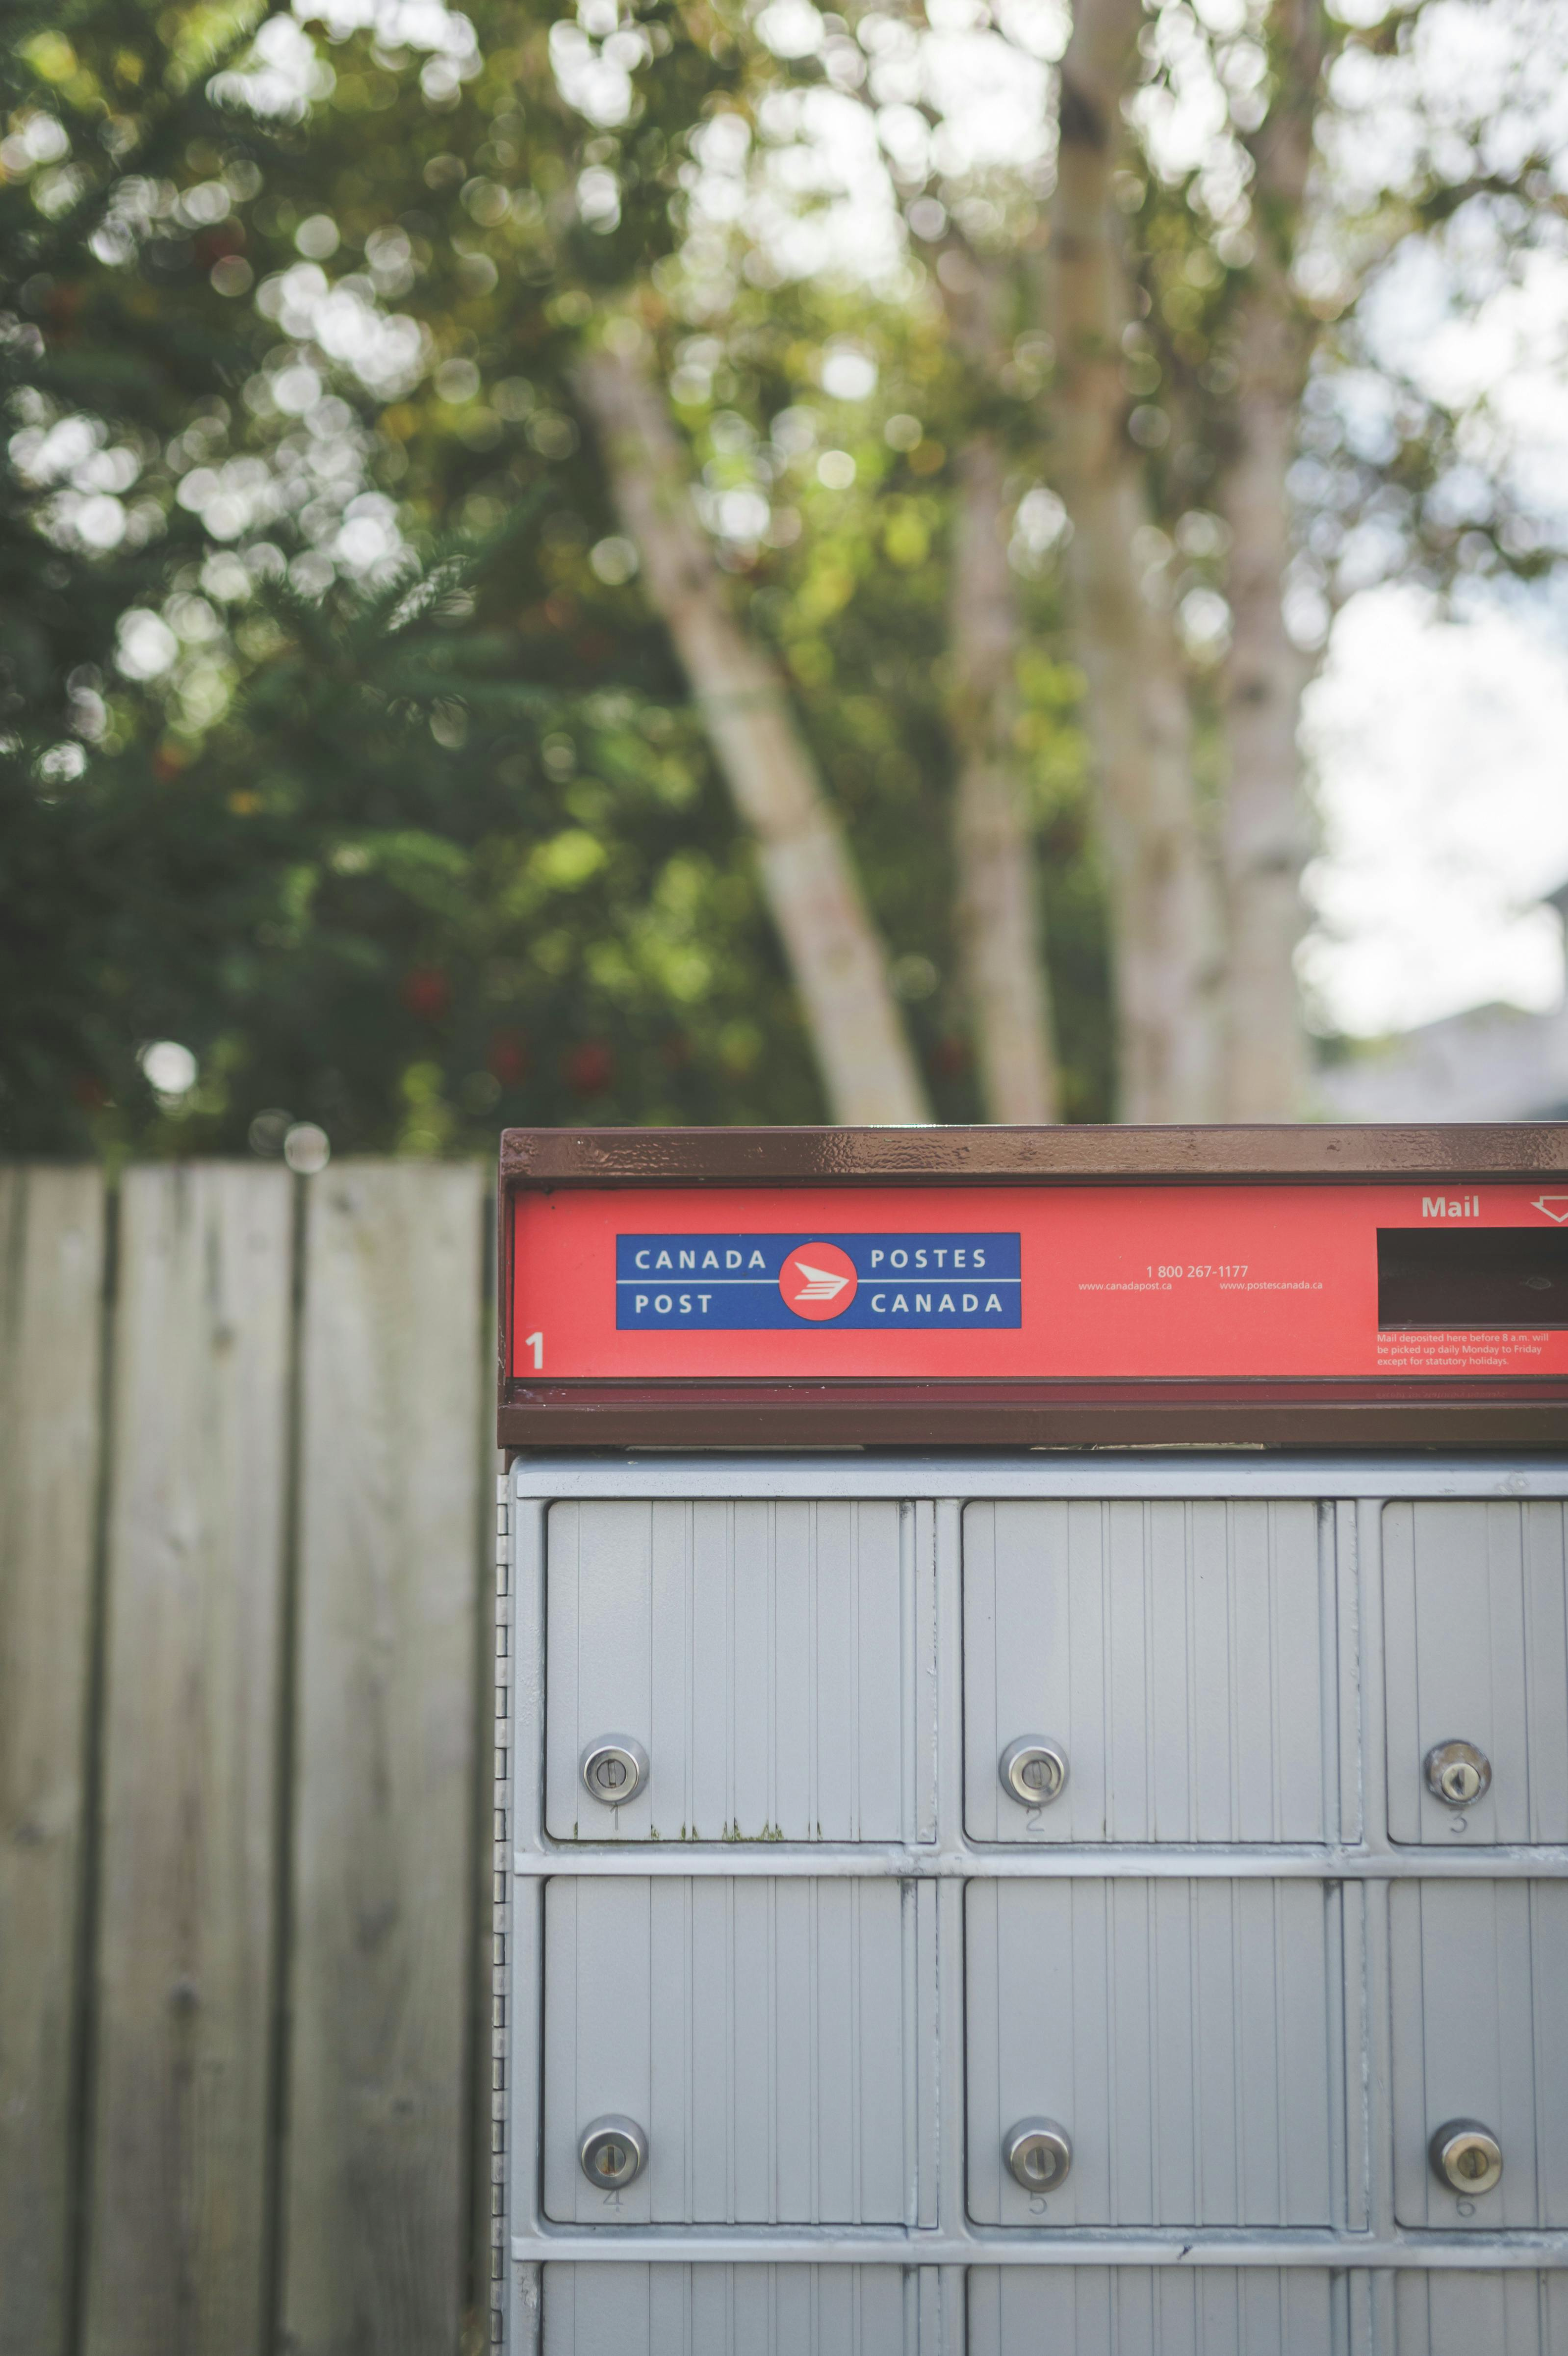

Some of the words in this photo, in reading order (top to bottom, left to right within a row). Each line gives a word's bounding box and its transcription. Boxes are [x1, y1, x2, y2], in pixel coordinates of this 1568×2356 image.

[1422, 1196, 1479, 1217] Mail
[635, 1250, 766, 1269] CANADA
[871, 1249, 985, 1268] POSTES
[1147, 1266, 1152, 1278] 1
[1158, 1266, 1183, 1278] 800
[1187, 1265, 1248, 1278] 267-1177
[1078, 1281, 1172, 1292] www.canadapost.ca
[1220, 1280, 1323, 1291] www.postescanada.ca
[635, 1294, 712, 1314] POST
[871, 1293, 1002, 1313] CANADA
[1377, 1334, 1397, 1342] Mail
[1399, 1334, 1444, 1343] deposited
[1446, 1334, 1467, 1342] here
[1470, 1333, 1500, 1342] before
[1502, 1333, 1508, 1342] 8
[1532, 1333, 1549, 1341] will
[525, 1331, 543, 1370] 1
[1377, 1346, 1389, 1354] be
[1391, 1345, 1421, 1355] picked
[1423, 1347, 1436, 1355] up
[1437, 1345, 1460, 1355] daily
[1462, 1345, 1500, 1355] Monday
[1514, 1344, 1542, 1355] Friday
[1377, 1358, 1407, 1367] except
[1410, 1357, 1423, 1365] for
[1425, 1358, 1467, 1367] statutory
[1469, 1357, 1509, 1366] holidays.
[1026, 1805, 1045, 1832] 2
[1449, 1807, 1468, 1833] 3
[603, 2189, 624, 2212] 4
[1029, 2190, 1047, 2215] 5
